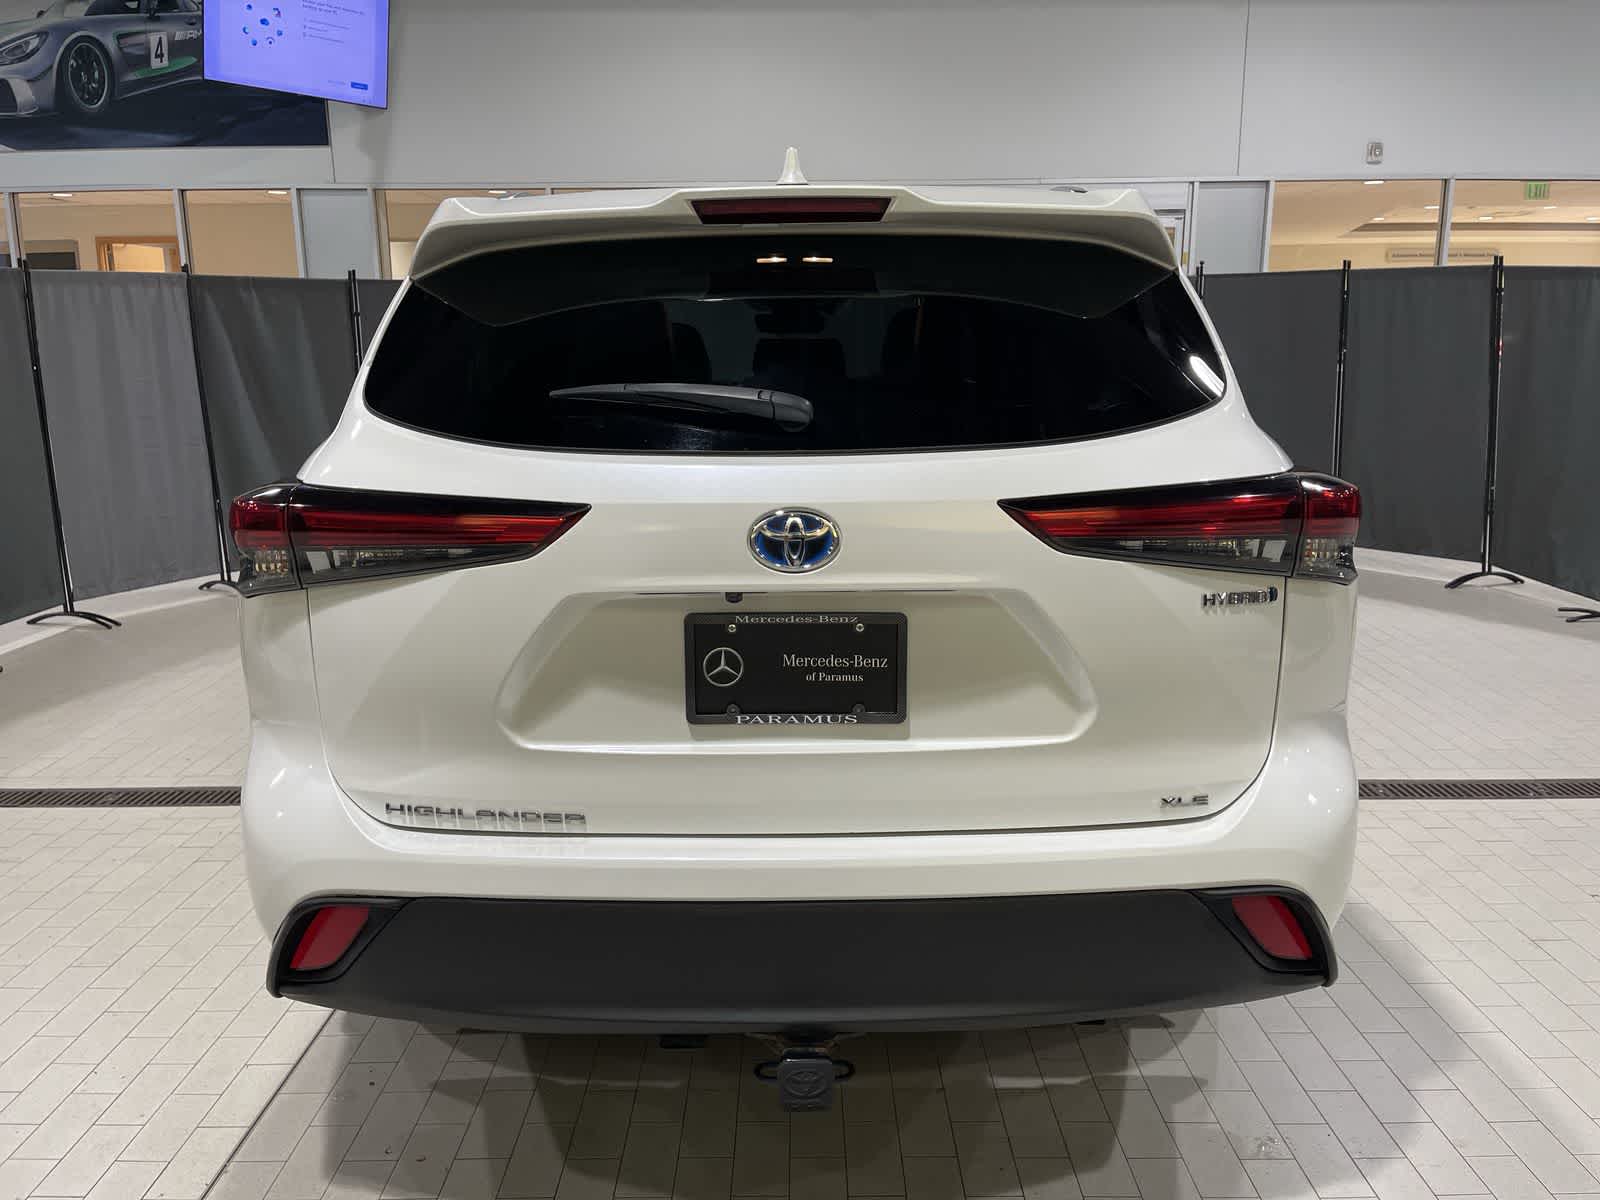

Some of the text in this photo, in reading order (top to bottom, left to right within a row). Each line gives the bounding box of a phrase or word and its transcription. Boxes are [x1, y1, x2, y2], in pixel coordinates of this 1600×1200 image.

[154, 35, 165, 64] 4
[1203, 591, 1267, 606] HYBRID
[735, 615, 859, 624] Mercedes-Benz
[783, 654, 888, 668] Mercedes-Benz
[806, 672, 864, 682] of Paramus
[736, 714, 858, 725] PARAMUS
[1160, 795, 1208, 808] XLE
[385, 803, 586, 824] HIGHLANDER
